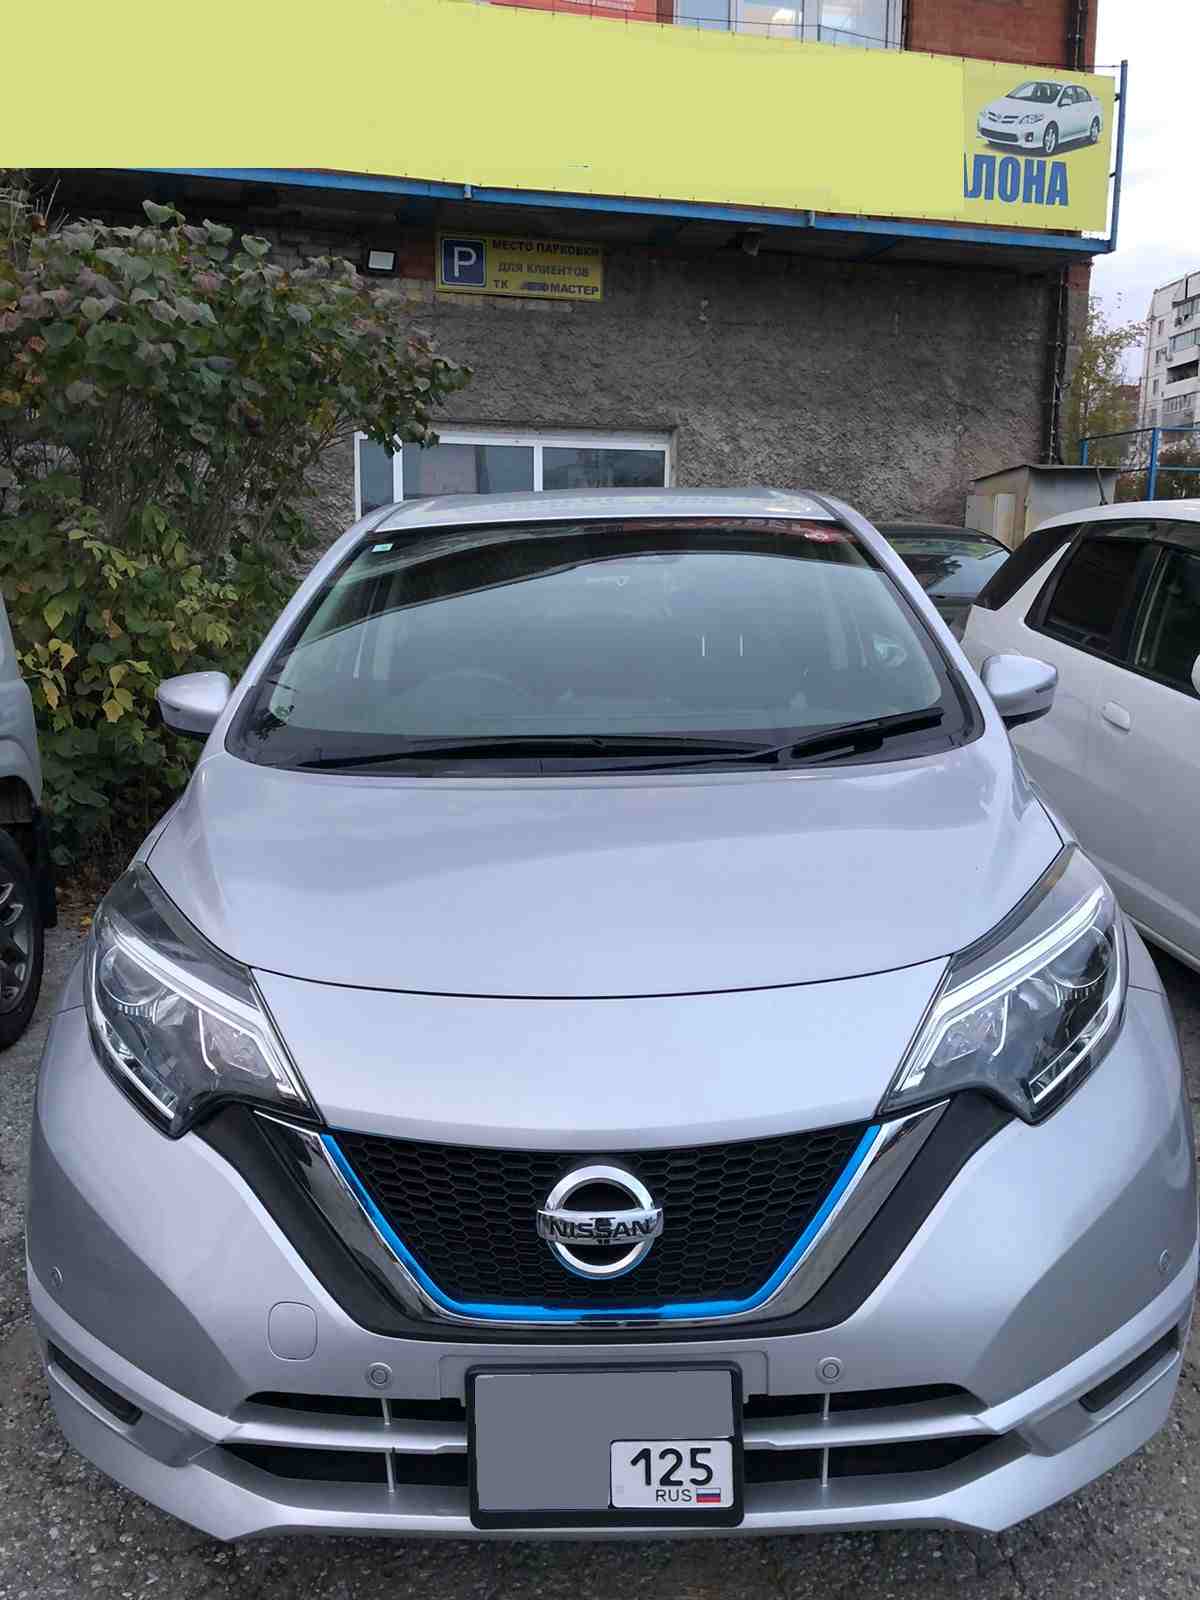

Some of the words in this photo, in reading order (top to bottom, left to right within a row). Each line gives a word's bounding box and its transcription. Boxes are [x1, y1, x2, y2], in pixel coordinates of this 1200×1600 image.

[964, 153, 1069, 206] ЛОНА
[492, 239, 534, 253] МЕСТО
[453, 246, 477, 278] P
[497, 261, 523, 274] ДЛЯ
[526, 263, 591, 277] КЛИЕНТОВ
[493, 279, 510, 290] ТК
[549, 1218, 655, 1239] NISSAN
[630, 1447, 713, 1487] 125
[655, 1489, 692, 1503] RUS
